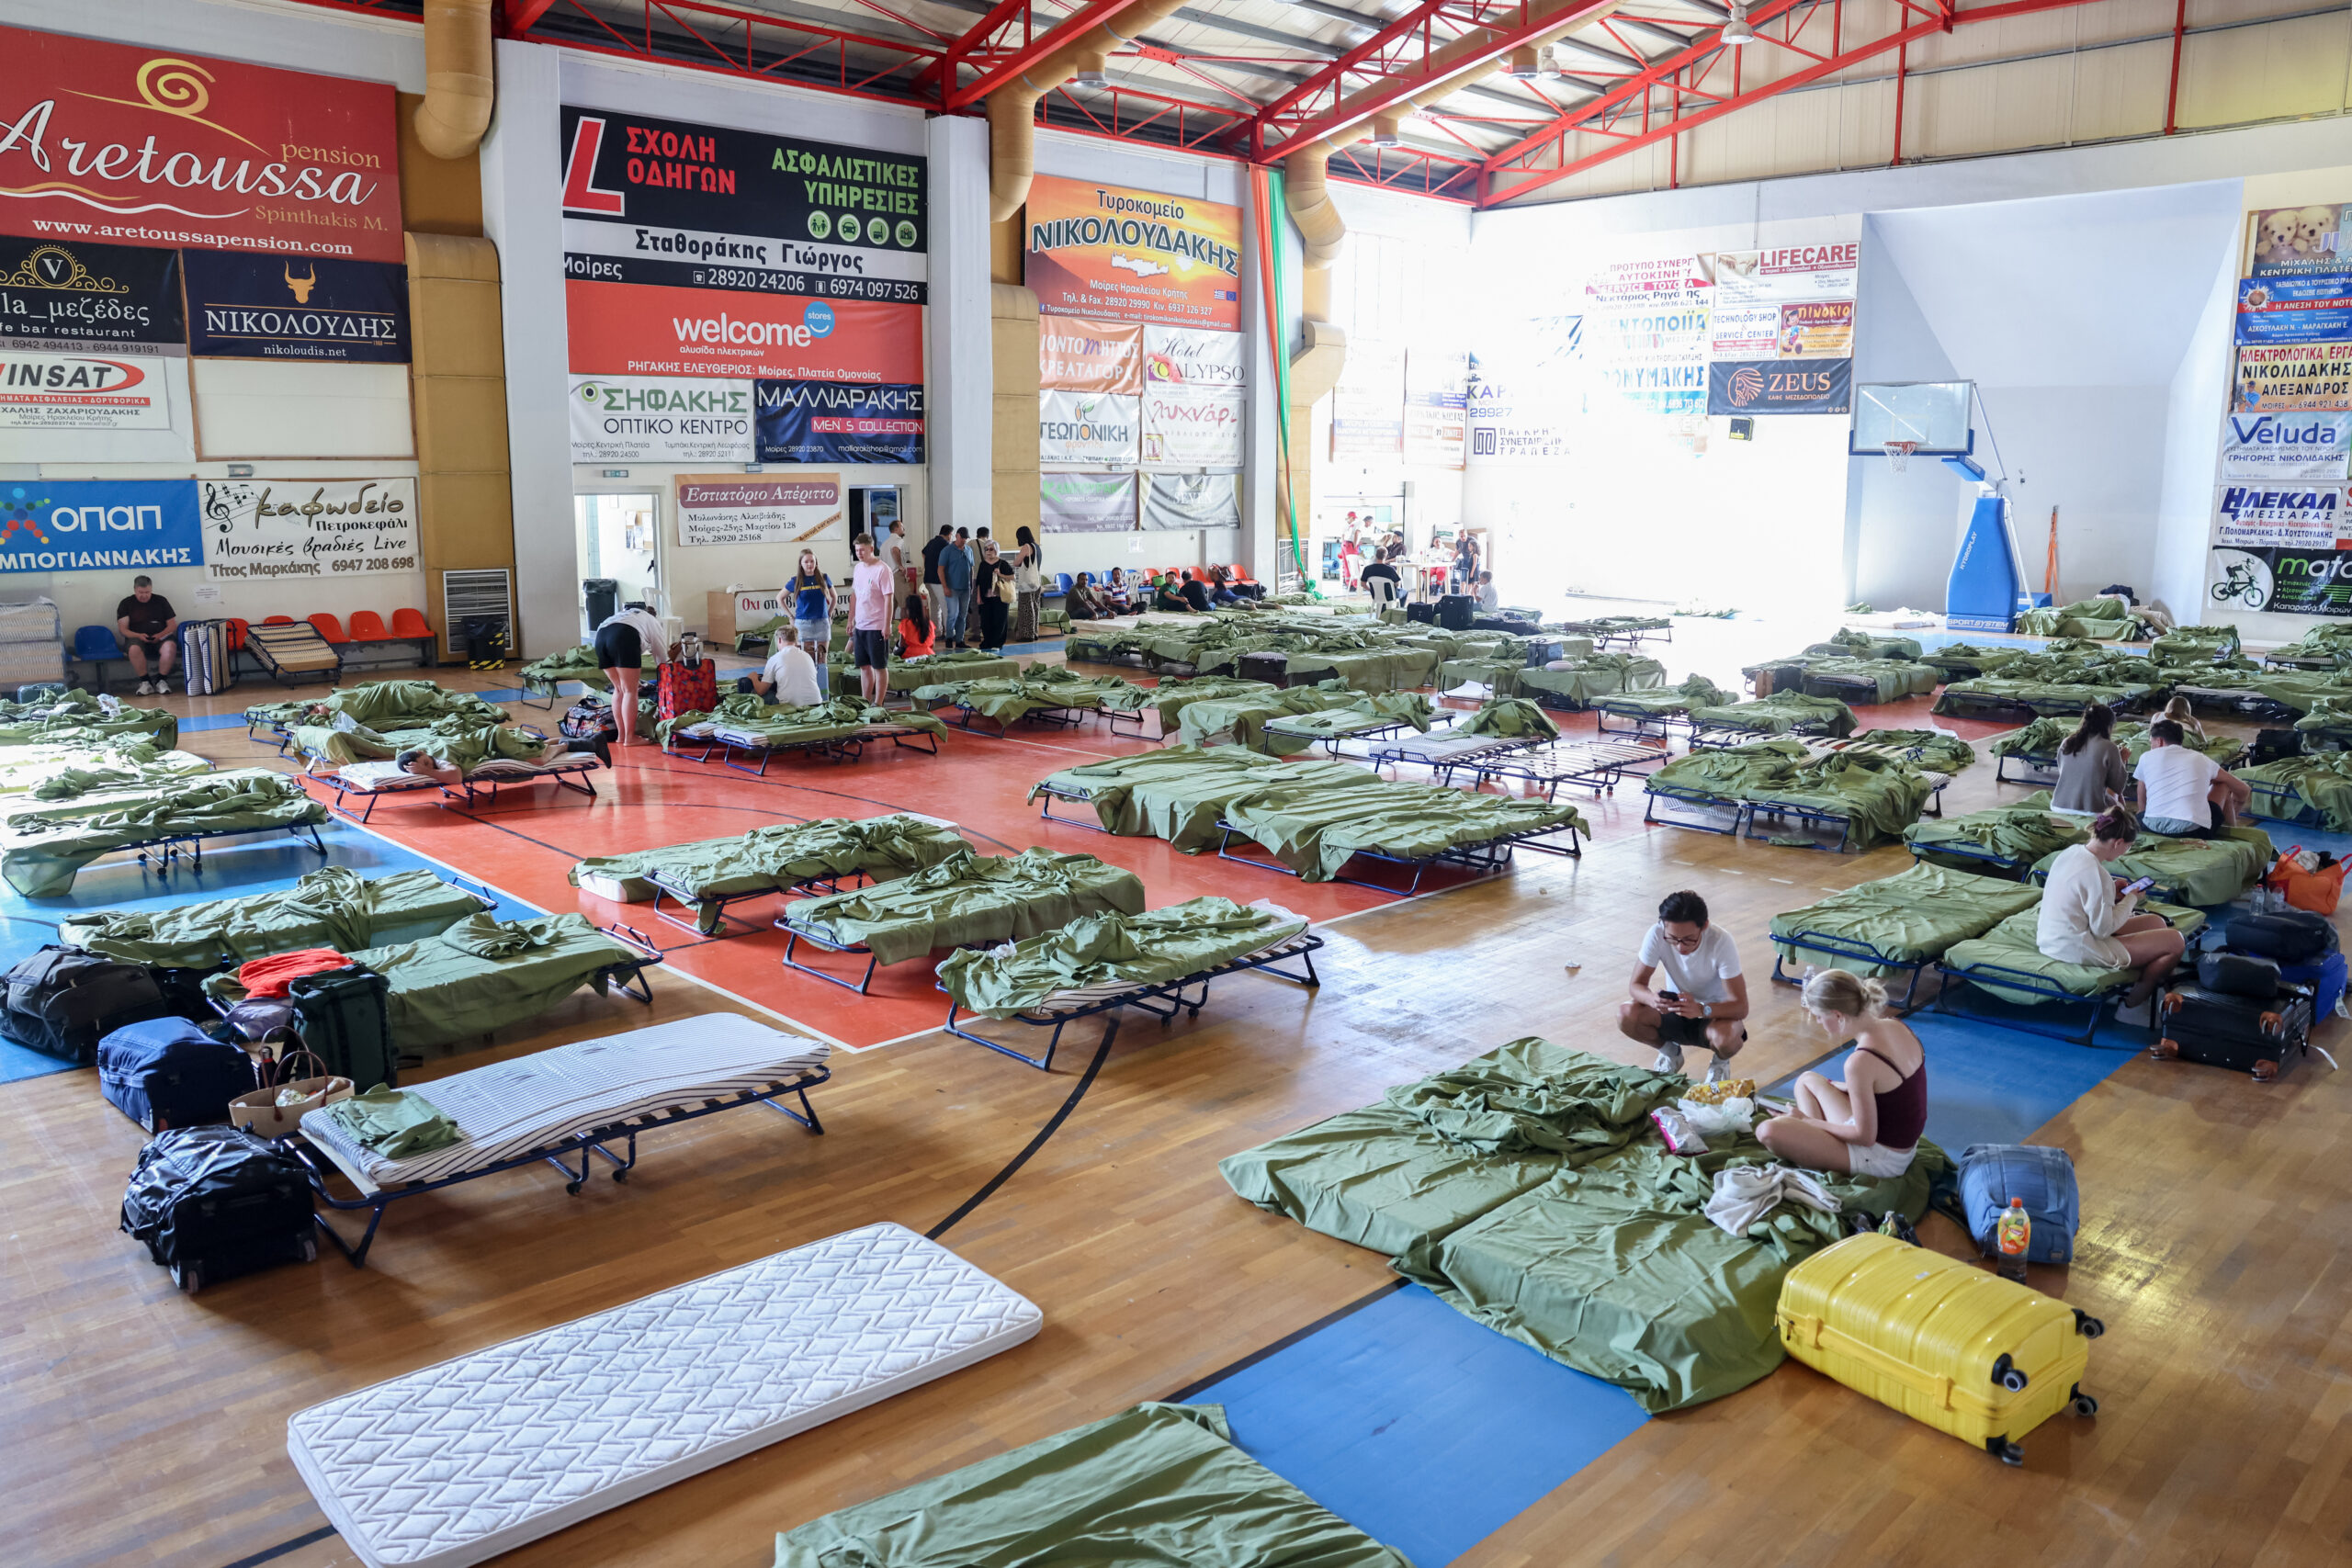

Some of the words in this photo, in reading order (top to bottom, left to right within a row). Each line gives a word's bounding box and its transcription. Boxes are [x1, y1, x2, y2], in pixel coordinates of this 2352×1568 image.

[0, 99, 378, 206] Aretoussa
[627, 126, 715, 164] ΣΧΟΛΗ
[281, 143, 381, 168] pension
[771, 147, 919, 187] ΑΣΦΑΛΙΣΤΙΚΕΣ
[627, 159, 736, 195] ΟΔΗΓΩΝ
[804, 180, 919, 215] ΥΠΗΡΕΣΙΕΣ
[1096, 189, 1184, 220] Τυροκομείο
[255, 205, 357, 229] Spinthakis
[363, 215, 389, 231] M.
[33, 219, 353, 254] www.aretoussapension.com
[636, 229, 766, 264] Σταθοράκης
[782, 243, 864, 273] Γιώργος
[1031, 217, 1238, 277] ΝΙΚΟΛΟΥΔΑΚΗΣ
[1760, 244, 1858, 267] LIFECARE
[42, 258, 63, 279] V
[1610, 261, 1654, 272] ΠΡΟΤΥΠΟ
[2280, 257, 2331, 266] ΜΙΧΑΛΗΣ
[563, 255, 623, 279] Μοίρες
[708, 268, 756, 288] 28920
[759, 271, 806, 291] 24206
[830, 278, 865, 296] 6974
[867, 280, 892, 299] 097
[894, 282, 919, 299] 526
[2260, 267, 2312, 276] ΚΕΝΤΡΙΚΗ
[1090, 279, 1118, 292] Μοίρες
[1120, 283, 1160, 297] Ηρακλείου
[1162, 287, 1188, 300] Κρήτης
[1653, 279, 1694, 291] TOYOA
[0, 291, 150, 326] la_μεζέδες
[1046, 304, 1080, 315] Τυροκομείο
[1124, 313, 1143, 321] e-mail:
[1062, 292, 1079, 304] Τηλ.
[1080, 294, 1087, 303] &
[1089, 295, 1103, 306] Fax.
[1105, 297, 1127, 308] 28920
[1128, 299, 1150, 310] 29990
[1153, 300, 1167, 311] Κιν.
[1168, 301, 1185, 313] 6937
[1186, 304, 1199, 314] 126
[1200, 306, 1213, 316] 327
[1798, 305, 1850, 320] ΠΙΝΟΚΙΟ
[205, 310, 397, 339] ΝΙΚΟΛΟΥΔΗΣ
[808, 311, 831, 321] stores
[1714, 313, 1757, 323] TECHNOLOGY
[1758, 312, 1777, 321] SHOP
[2302, 321, 2342, 330] ΜΑΡΑΓΚΑΚΗ
[21, 323, 47, 333] bar
[54, 327, 136, 338] restaurant
[673, 311, 812, 347] welcome
[1716, 331, 1743, 340] SERVICE
[1747, 331, 1773, 339] CENTER
[12, 340, 40, 349] 6942
[43, 341, 83, 351] 494413
[93, 344, 119, 352] 6944
[122, 344, 159, 354] 919191
[264, 344, 346, 357] nikoloudis.net
[680, 346, 715, 355] αλυσίδα
[717, 347, 764, 357] ηλεκτρικών
[1158, 337, 1204, 357] Hotel
[2241, 347, 2323, 362] ΗΛΕΚΤΡΟΛΟΓΙΚΑ
[0, 364, 111, 389] INSAT
[628, 360, 681, 372] ΡΗΓΑΚΗΣ
[684, 362, 755, 375] ΕΛΕΥΘΕΡΙΟΣ:
[759, 365, 795, 378] Μοίρες,
[797, 367, 834, 378] Πλατεία
[837, 368, 881, 381] Ομονοίας
[1040, 359, 1133, 380] ΚΡΕΑΤΑΓΟΡΑ
[1158, 362, 1245, 381] CALYPSO
[2243, 362, 2351, 378] ΝΙΚΟΛΙΔΑΚΗΣ
[1769, 372, 1831, 392] ZEUS
[2262, 382, 2349, 396] ΑΛΕΞΑΝΔΡΟΣ
[603, 389, 748, 413] ΣΗΦΑΚΗΣ
[758, 387, 922, 411] ΜΑΛΛΙΑΡΑΚΗΣ
[2299, 400, 2316, 409] 6944
[2335, 400, 2348, 408] 438
[47, 408, 141, 416] ΖΑΧΑΡΙΟΥΔΑΚΗΣ
[1151, 400, 1238, 427] λυχνάρι
[1470, 407, 1514, 418] 29927
[604, 418, 673, 434] ΟΠΤΙΚΟ
[681, 419, 748, 434] ΚΕΝΤΡΟ
[859, 422, 922, 433] COLLECTION
[1040, 423, 1128, 442] ΓΕΩΠΟΝΙΚΗ
[2231, 416, 2336, 444] Veluda
[625, 440, 650, 448] Πλατεία
[765, 446, 787, 454] Μοίρες
[1499, 447, 1571, 456] ΤΡΑΠΕΖΑ
[2228, 454, 2275, 462] ΓΡΗΓΟΡΗΣ
[2279, 454, 2344, 462] ΝΙΚΟΛΙΔΑΚΗΣ
[685, 486, 767, 504] Εστιατόριο
[771, 485, 834, 503] Απέριττο
[2221, 488, 2336, 514] ΗΛΕΚΑΛ
[254, 483, 403, 529] καφωδείο
[2244, 510, 2333, 520] ΜΕΣΣΑΡΑΣ
[316, 518, 408, 533] Πετροκεφάλι
[688, 513, 739, 522] Μυλωνάκης
[741, 513, 786, 521] Αλκιβιάδης
[688, 525, 743, 533] Μοίρες-25ης
[745, 523, 781, 531] Μαρτίου
[216, 537, 294, 558] Μουσικές
[302, 536, 364, 560] βραδιές
[373, 536, 406, 549] Live
[688, 536, 709, 546] Τηλ.
[1960, 531, 1977, 570] HYDROPLAY
[0, 547, 191, 570] ΜΠΟΓΙΑΝΝΑΚΗΣ
[210, 563, 247, 578] Τίτος
[250, 561, 321, 577] Μαρκάκης
[332, 559, 363, 571] 6947
[366, 558, 389, 570] 208
[391, 557, 414, 569] 698
[2273, 602, 2316, 612] Καπαριανά
[2319, 604, 2351, 615] Μοιρών
